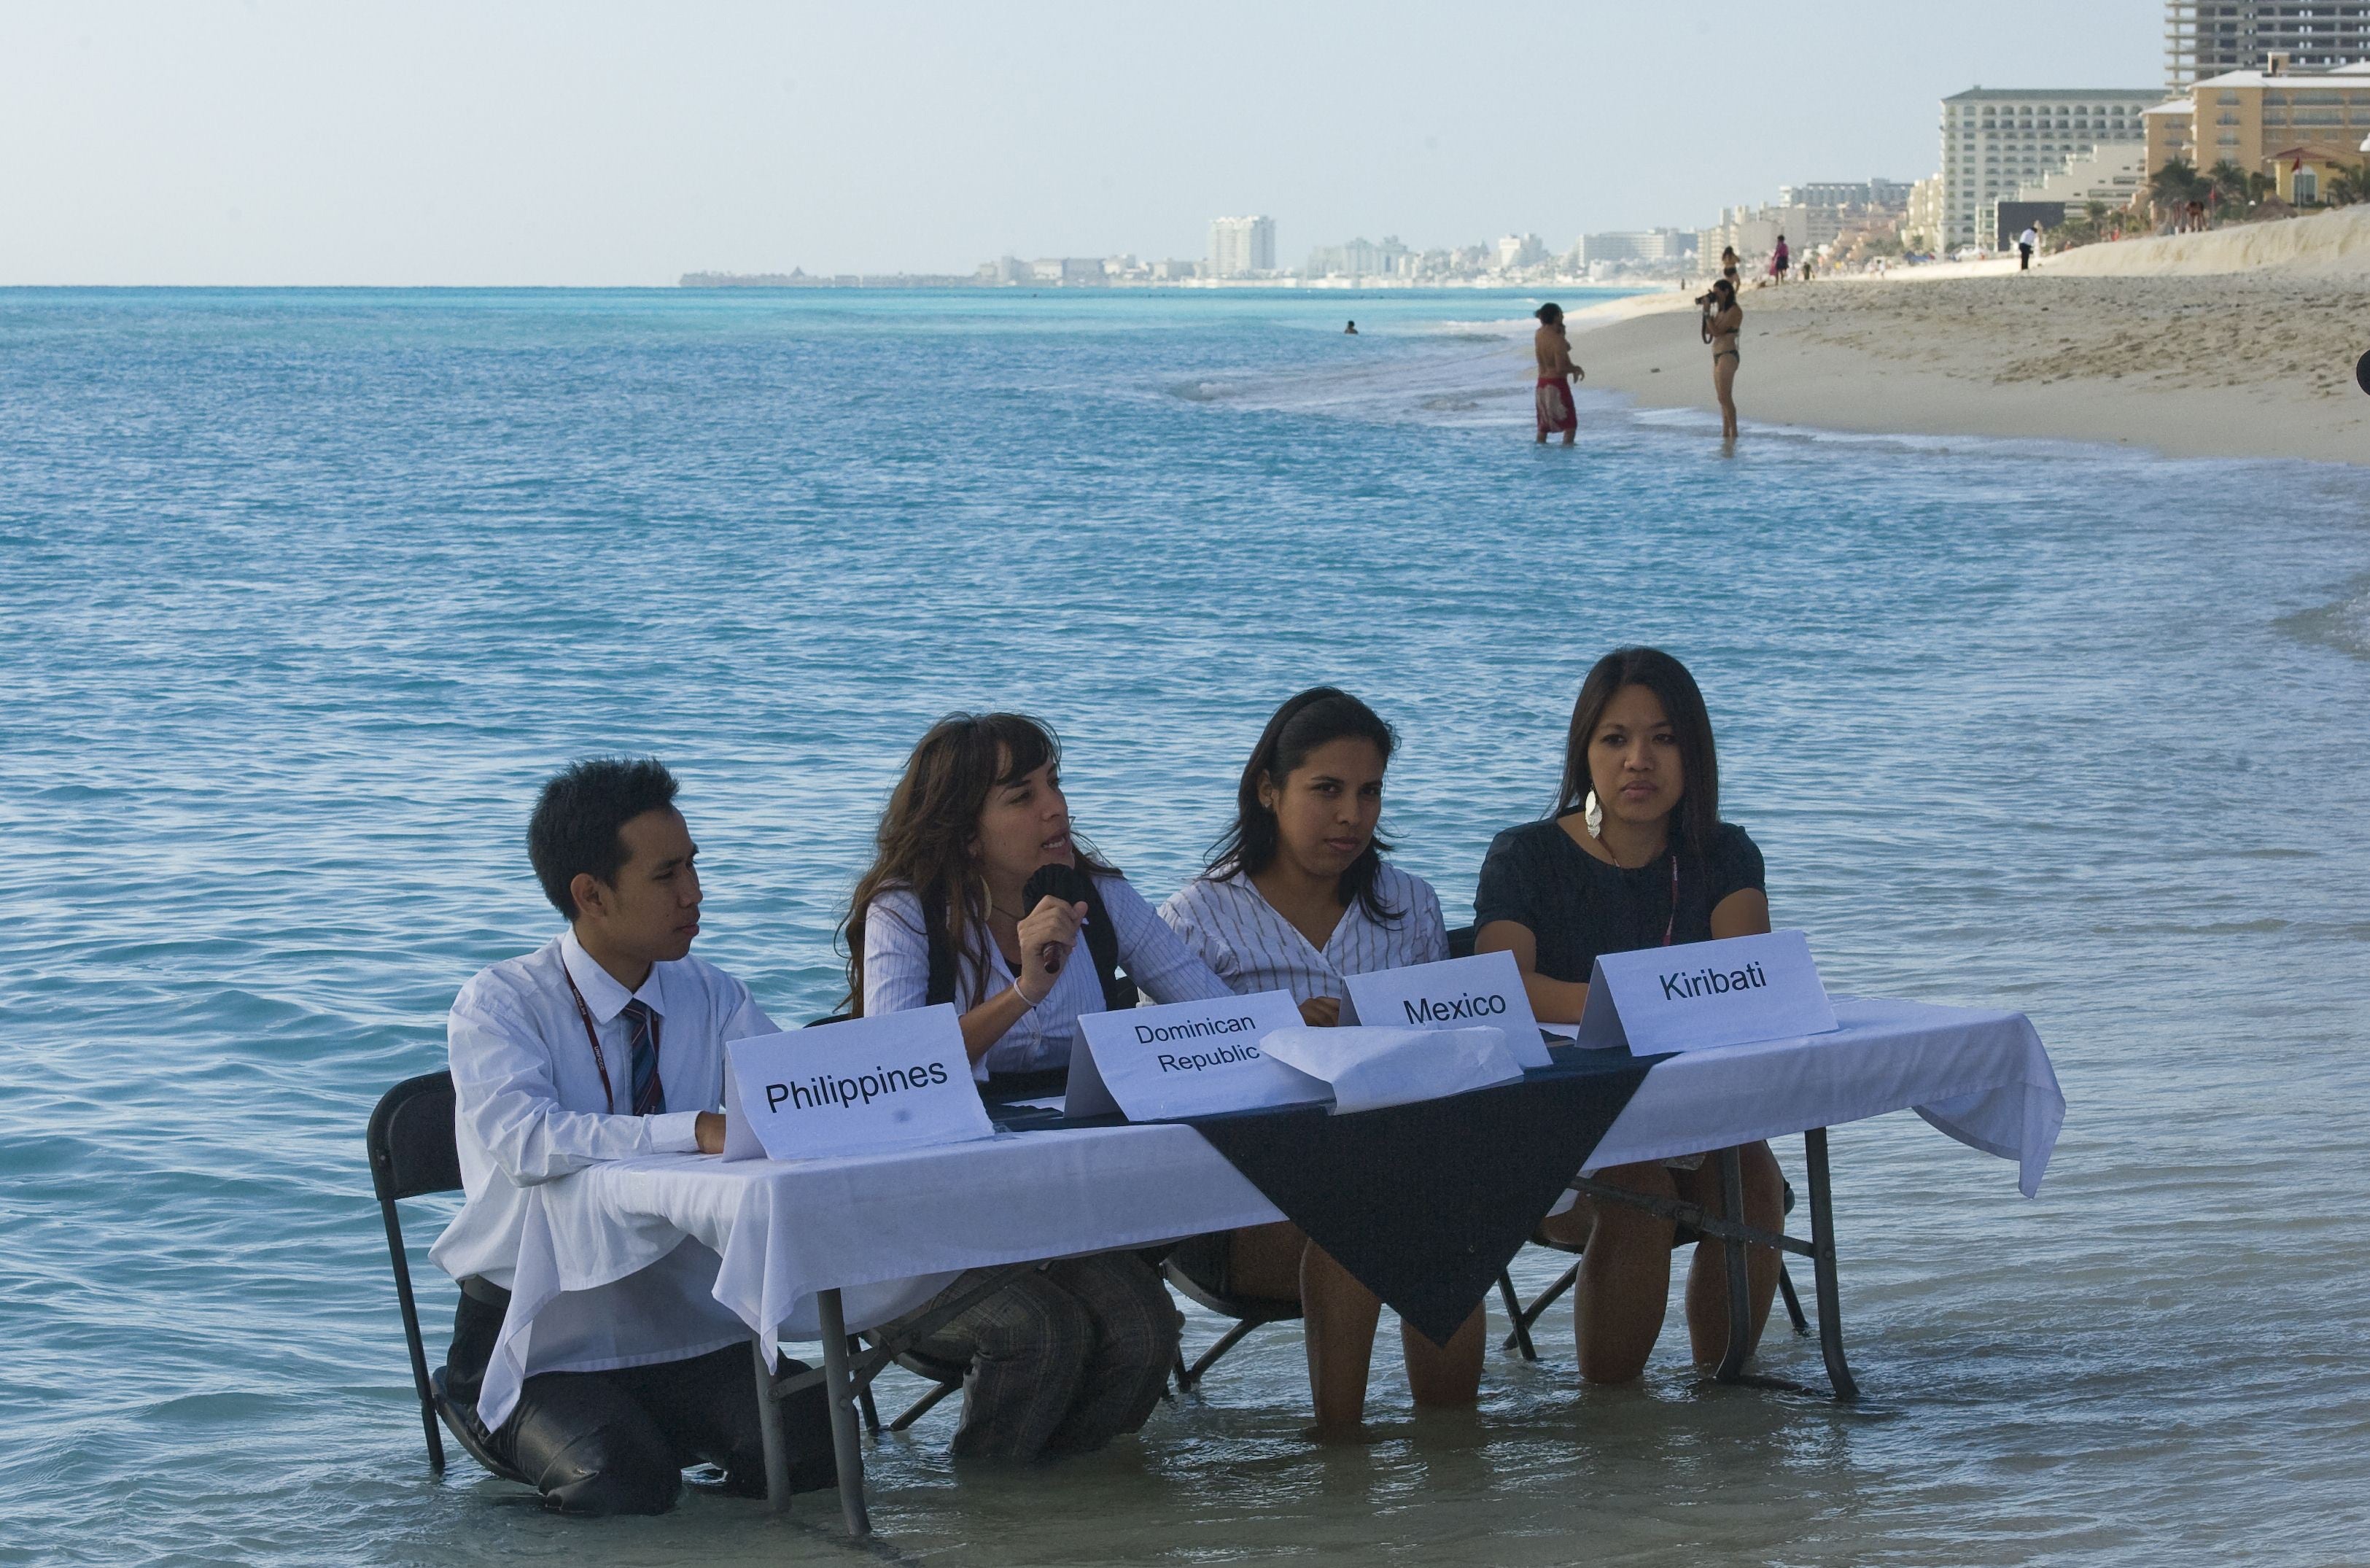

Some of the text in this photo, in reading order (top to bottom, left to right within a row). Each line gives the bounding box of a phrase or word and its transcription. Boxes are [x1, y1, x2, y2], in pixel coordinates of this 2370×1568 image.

[1659, 960, 1767, 1000] Kiribati
[1403, 993, 1506, 1025] Mexico
[1135, 1017, 1256, 1044] Dominican
[1157, 1044, 1260, 1072] Republic
[766, 1062, 948, 1113] Philippines
